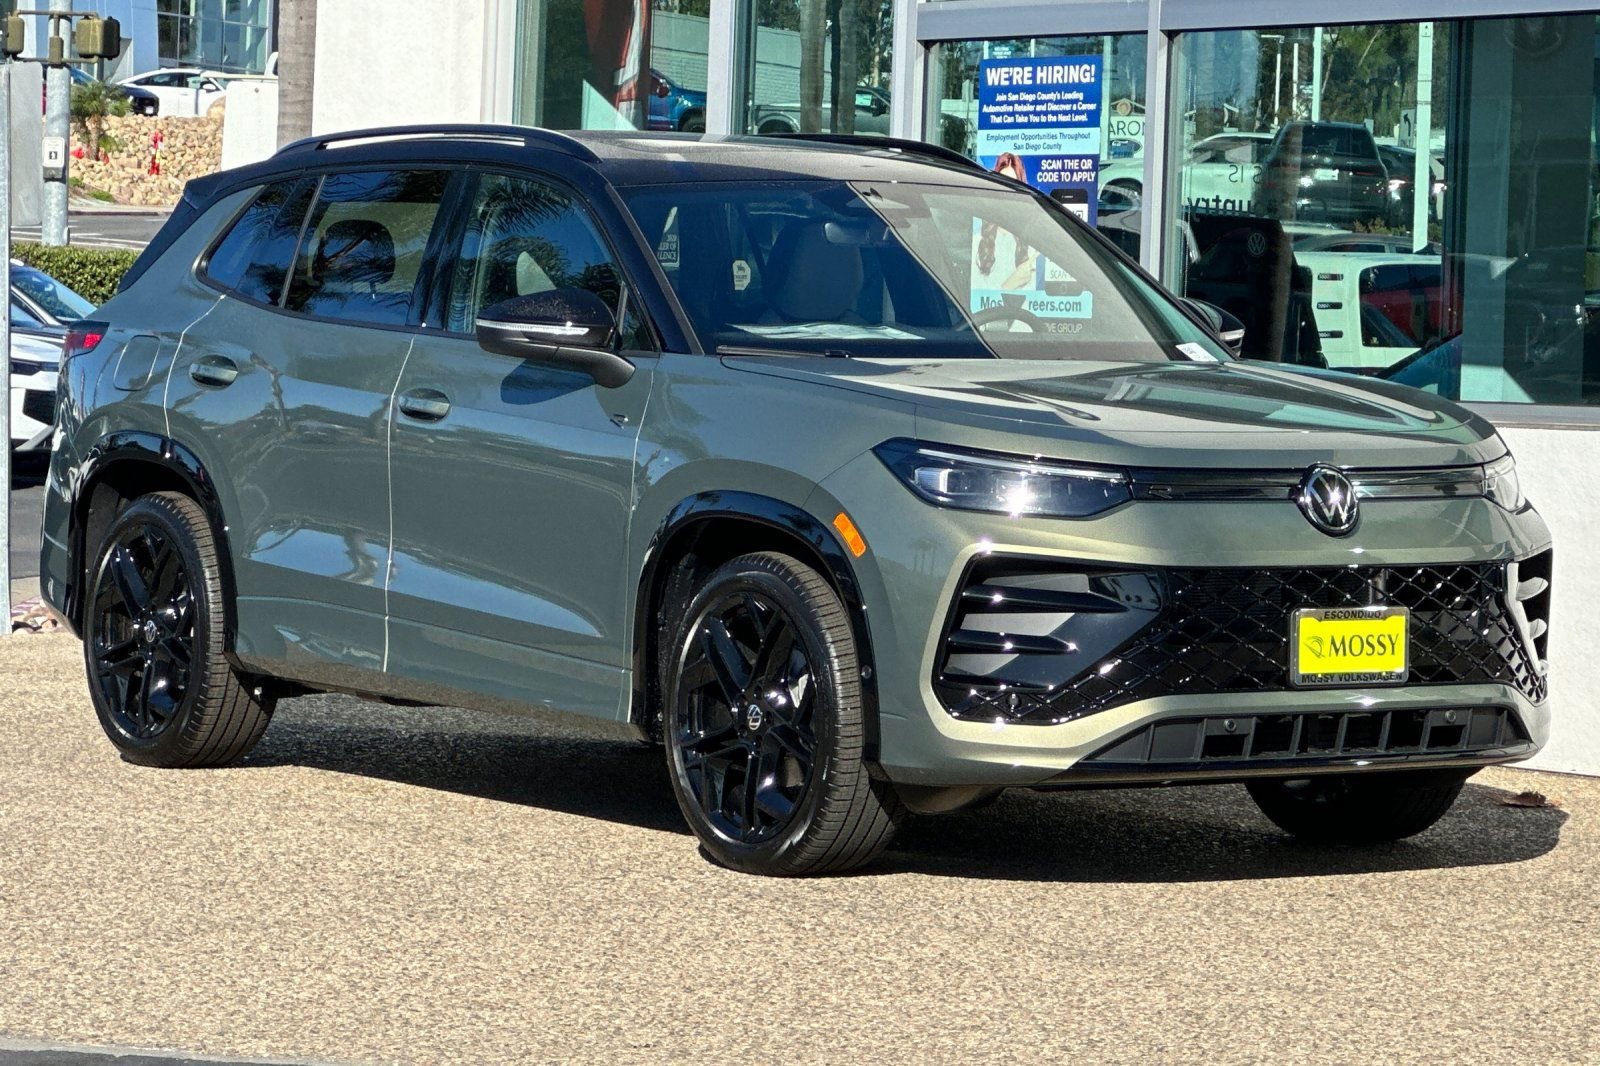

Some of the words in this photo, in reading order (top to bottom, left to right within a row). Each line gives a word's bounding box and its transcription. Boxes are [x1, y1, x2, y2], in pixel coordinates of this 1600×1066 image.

[986, 66, 1033, 86] WE'RE
[1036, 64, 1096, 84] HIRING!
[995, 93, 1007, 102] Join
[1007, 92, 1018, 101] San
[1019, 92, 1036, 102] Diego
[1036, 91, 1061, 101] County's
[1061, 91, 1083, 101] Leading
[982, 104, 1013, 113] Automotive
[1014, 103, 1035, 112] Retailer
[1035, 103, 1047, 111] and
[1047, 103, 1072, 111] Discover
[1077, 102, 1097, 110] Career
[990, 115, 1002, 123] That
[1003, 115, 1015, 123] Can
[1015, 114, 1028, 123] Take
[1029, 114, 1040, 122] You
[1040, 114, 1047, 122] to
[1047, 113, 1057, 122] the
[1057, 113, 1071, 121] Next
[986, 133, 1020, 142] Employment
[1020, 132, 1058, 141] Opportunities
[1058, 132, 1091, 140] Throughout
[1013, 143, 1024, 151] San
[1025, 142, 1041, 151] Diego
[1042, 142, 1062, 151] County
[1041, 159, 1062, 170] SCAN
[1063, 159, 1080, 170] THE
[1080, 159, 1093, 169] QR
[1037, 172, 1059, 183] CODE
[1059, 171, 1071, 182] TO
[1071, 171, 1096, 182] APPLY
[1324, 610, 1381, 620] ESCONDIDO
[1329, 633, 1400, 657] MOSSY
[1302, 674, 1337, 683] MOSSY
[1338, 672, 1403, 682] VOLKSWAGEN
